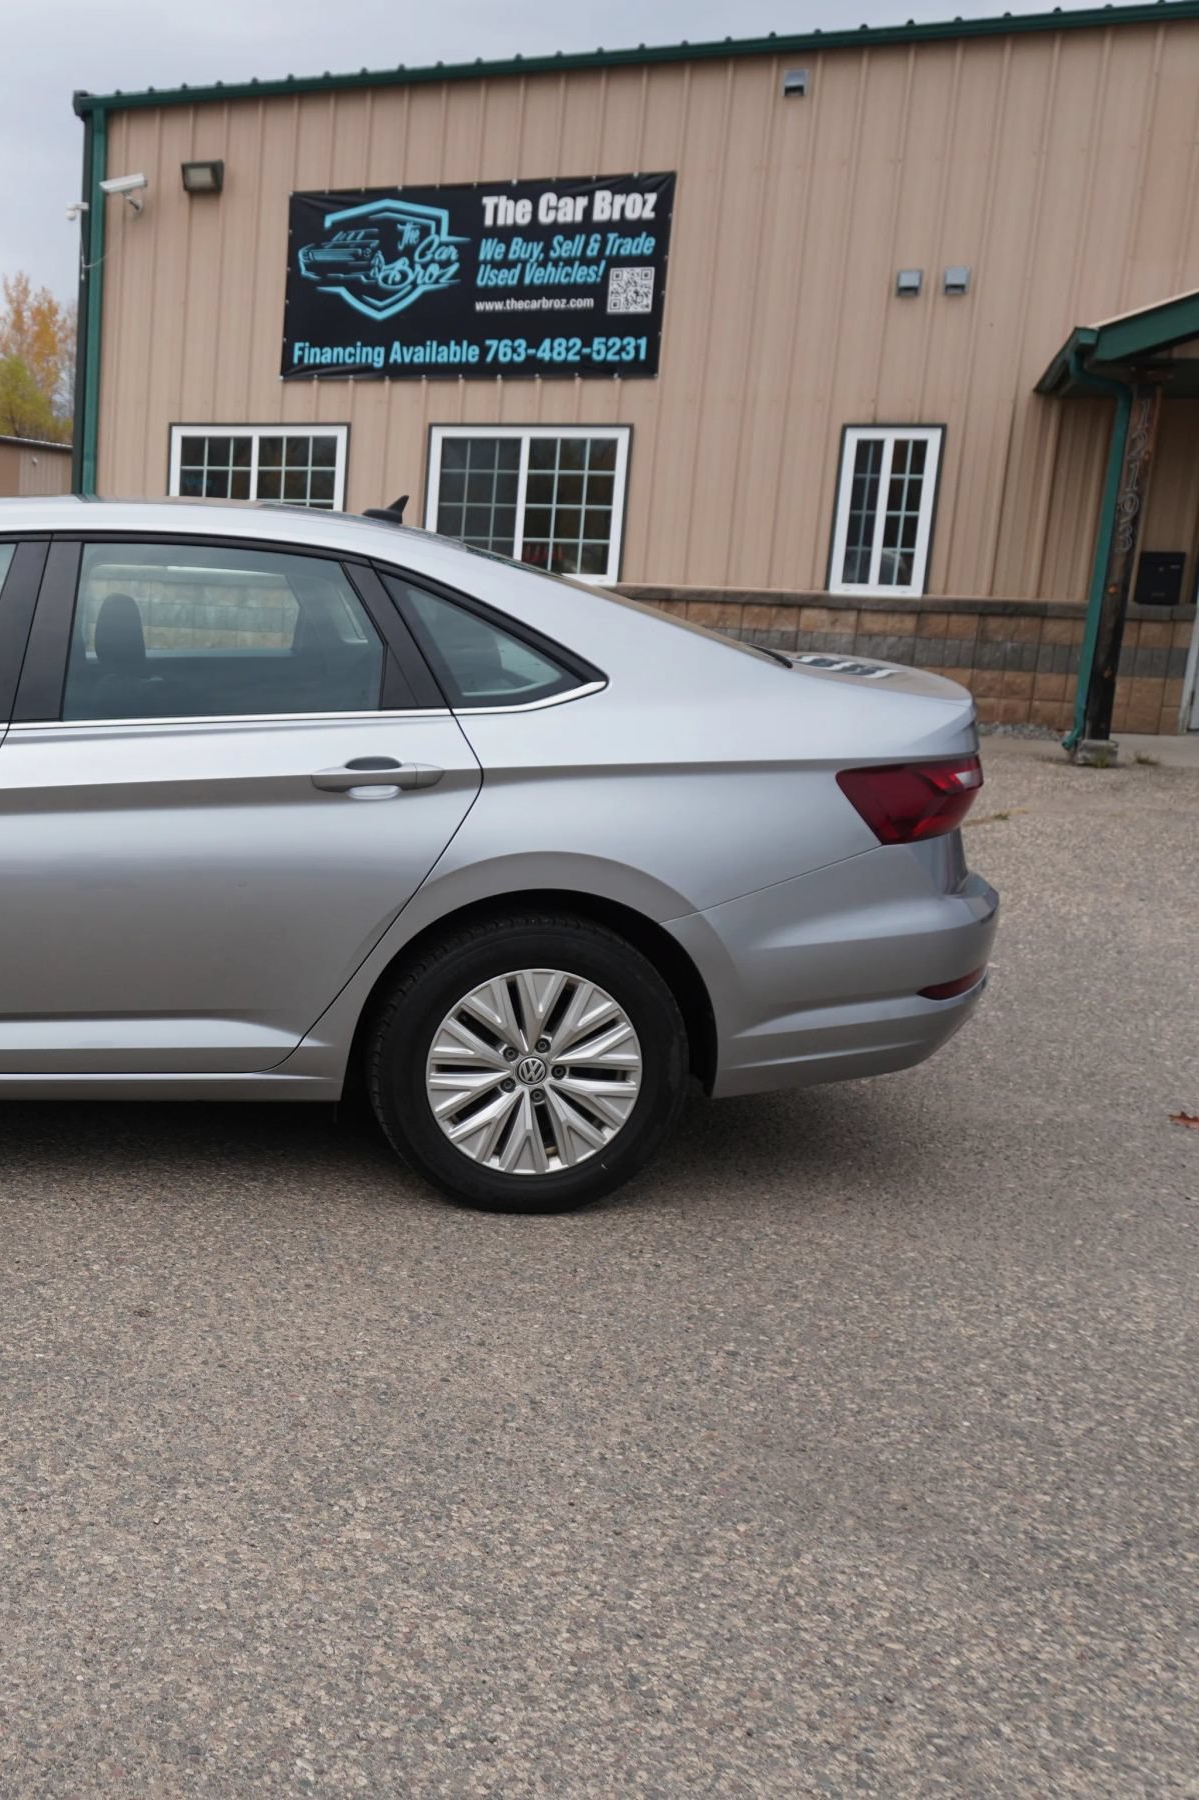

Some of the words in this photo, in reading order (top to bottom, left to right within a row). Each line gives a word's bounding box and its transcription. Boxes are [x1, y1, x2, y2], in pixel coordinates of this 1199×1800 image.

[482, 196, 533, 227] The
[538, 192, 588, 224] Car
[593, 190, 657, 222] Broz
[414, 234, 459, 262] Car
[479, 238, 506, 261] We
[508, 237, 544, 262] Buy,
[550, 234, 585, 258] Sell
[587, 233, 602, 256] &
[605, 231, 656, 256] Trade
[378, 257, 461, 289] Broz
[476, 263, 522, 287] Used
[524, 260, 606, 285] Vehicles!
[475, 297, 594, 312] www.thecarbroz.com
[293, 341, 385, 368] Financing
[389, 339, 480, 364] Available
[485, 336, 647, 363] 763-482-5231
